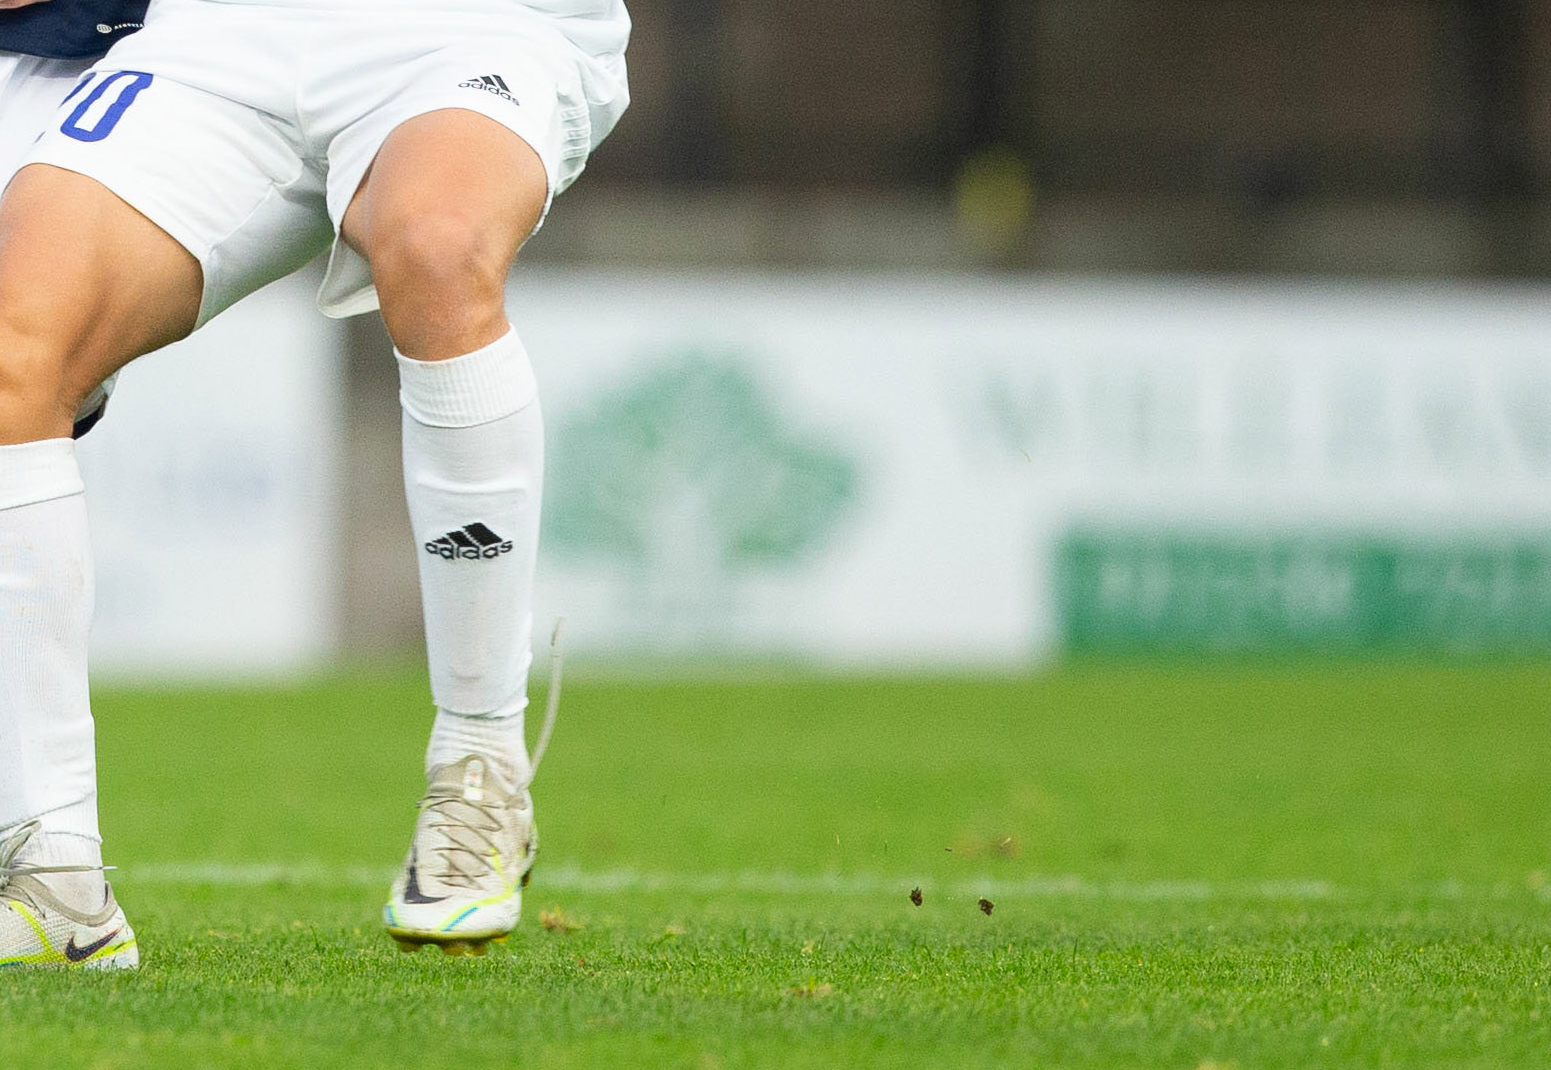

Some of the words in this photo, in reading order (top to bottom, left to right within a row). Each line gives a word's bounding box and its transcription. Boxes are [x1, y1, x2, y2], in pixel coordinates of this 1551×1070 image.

[458, 82, 520, 106] adidas
[33, 70, 154, 143] 0
[425, 540, 514, 560] adidas
